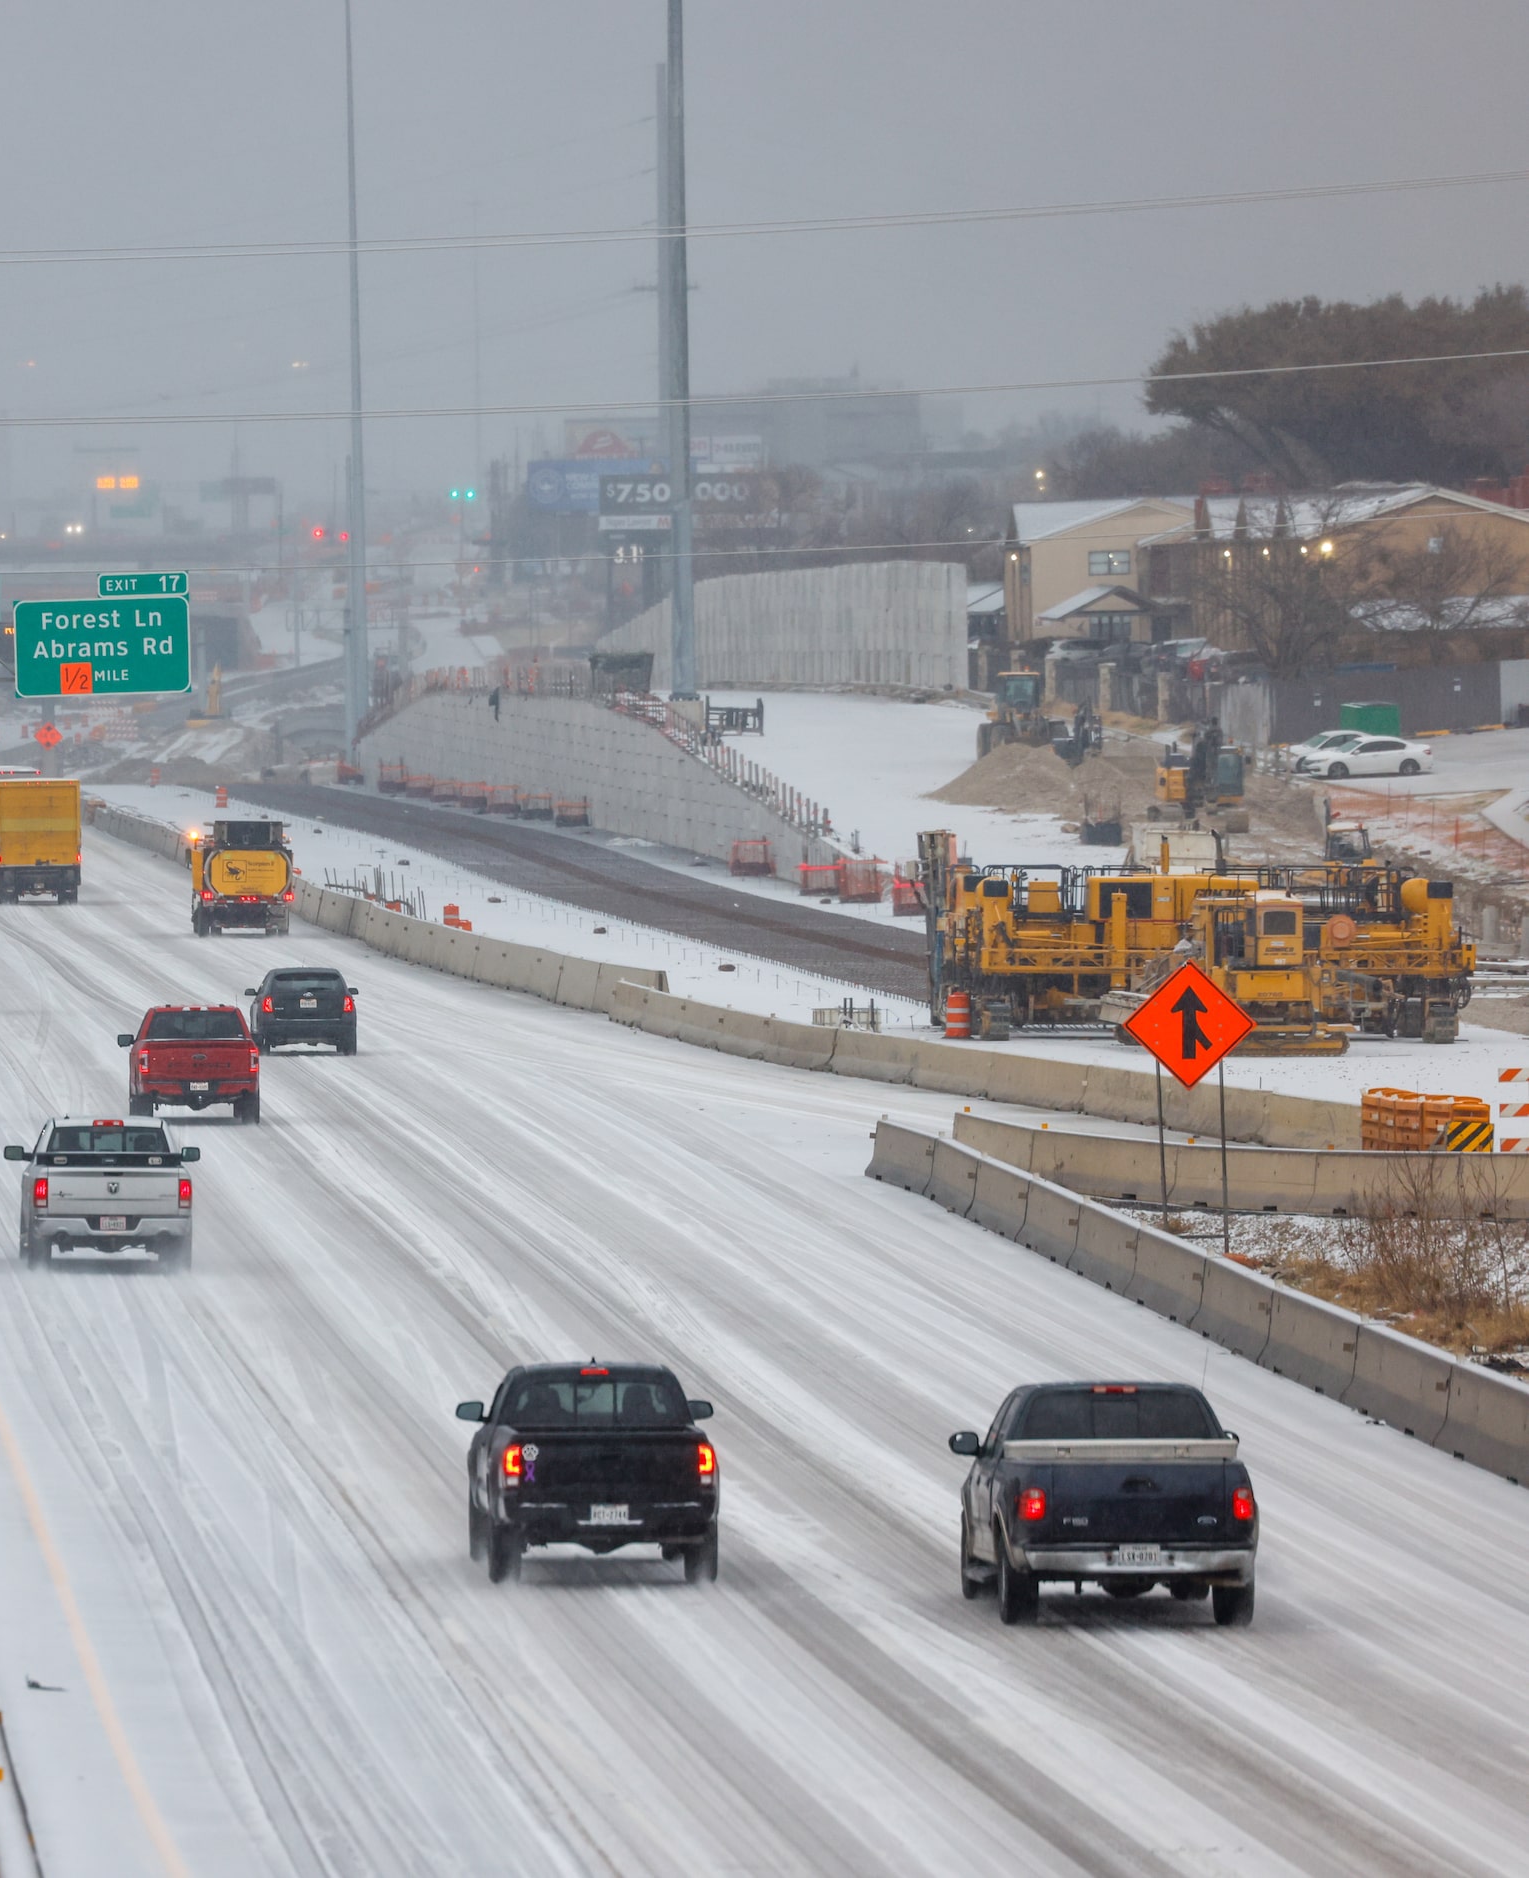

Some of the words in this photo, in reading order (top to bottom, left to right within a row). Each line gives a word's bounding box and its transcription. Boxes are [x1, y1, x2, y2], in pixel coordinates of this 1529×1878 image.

[105, 578, 138, 592] EXIT
[158, 575, 180, 592] 17
[41, 609, 120, 630] Forest
[134, 609, 162, 627] Ln
[32, 639, 129, 659] Abrams
[142, 635, 173, 655] Rd
[94, 669, 129, 682] MILE
